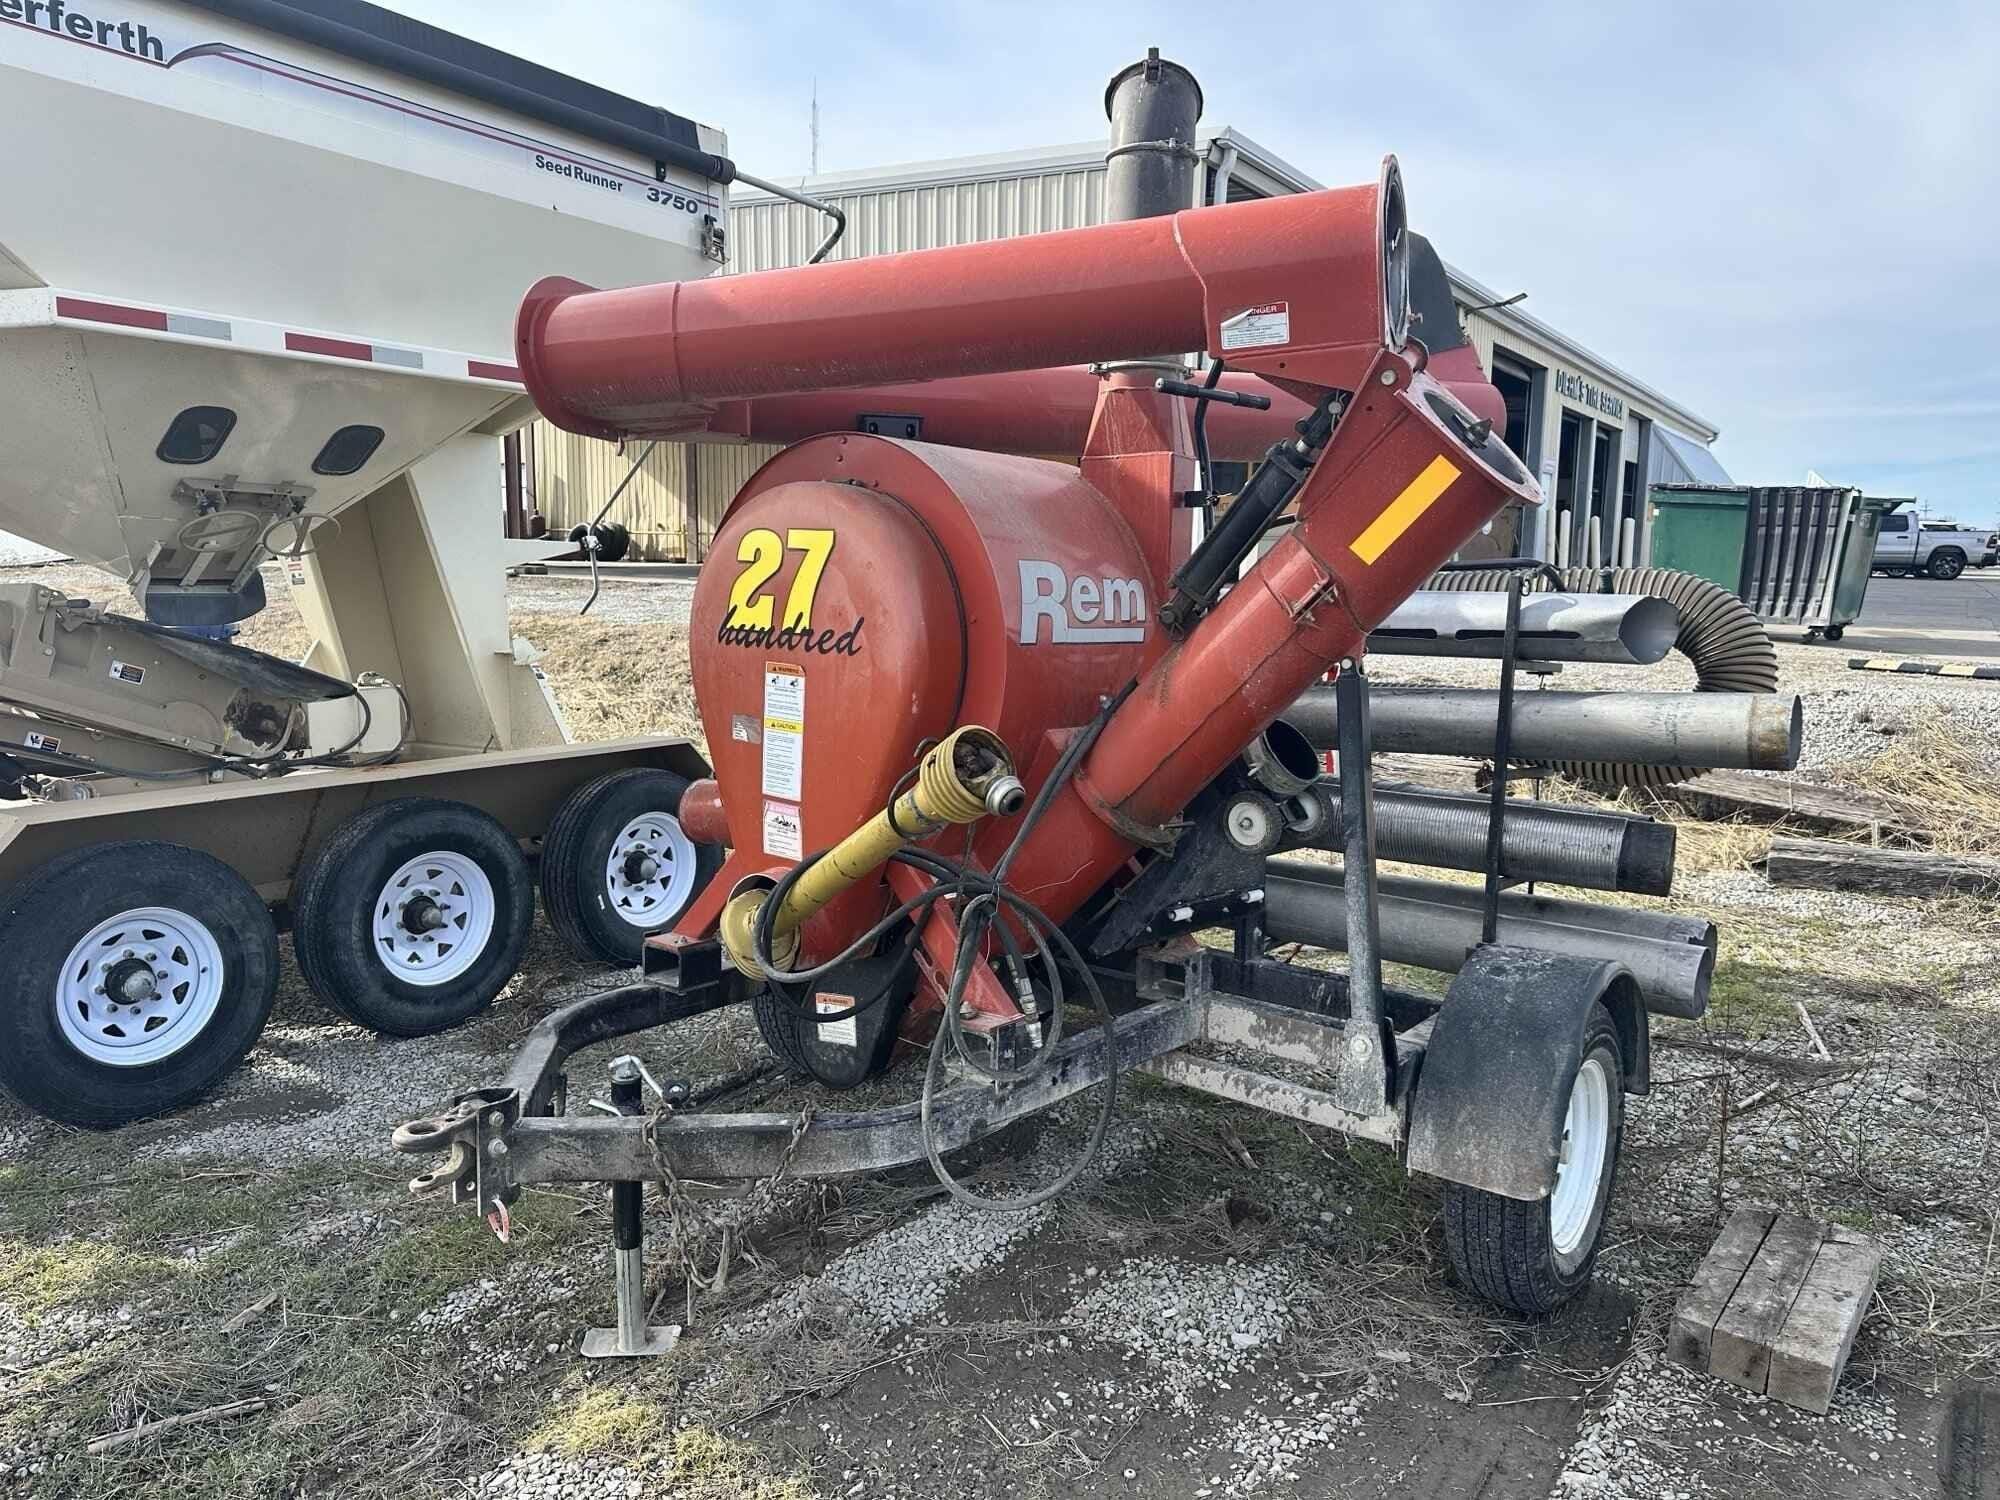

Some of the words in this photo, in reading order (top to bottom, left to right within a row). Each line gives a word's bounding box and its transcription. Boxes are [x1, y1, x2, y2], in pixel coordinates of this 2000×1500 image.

[646, 187, 699, 214] 3750
[728, 528, 836, 636] 27
[1018, 559, 1147, 645] Rem
[718, 603, 865, 656] hundred
